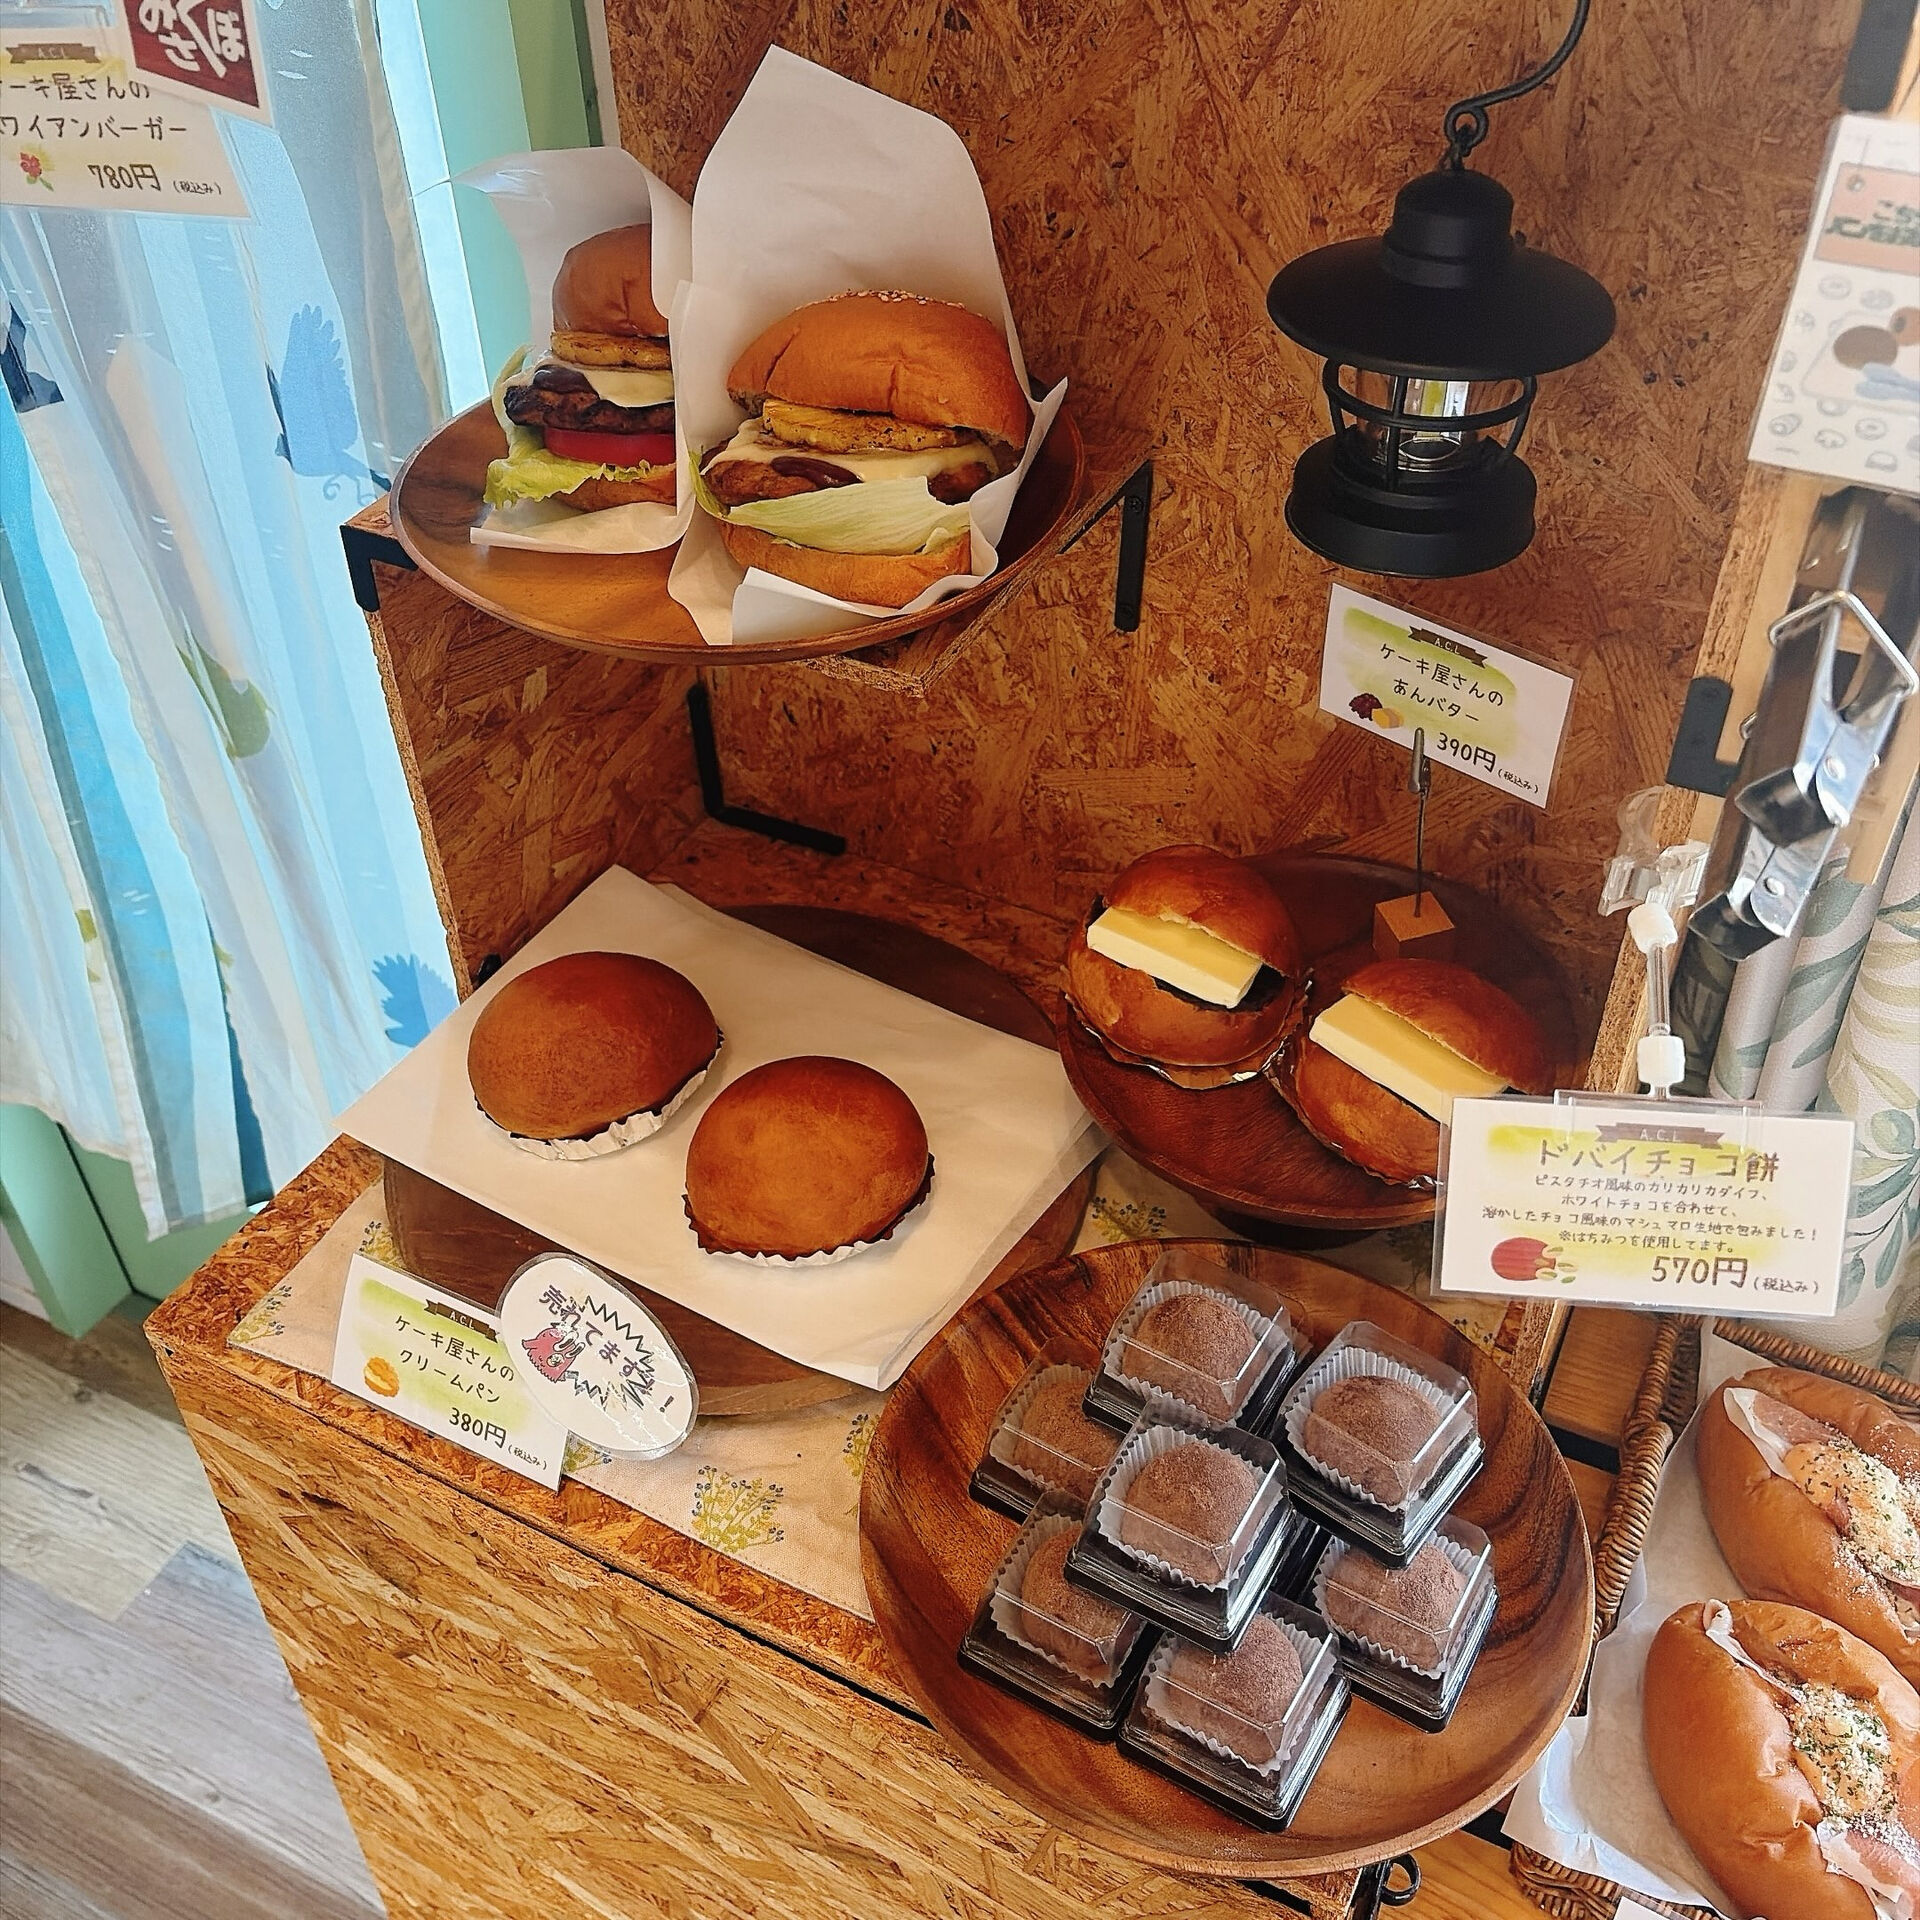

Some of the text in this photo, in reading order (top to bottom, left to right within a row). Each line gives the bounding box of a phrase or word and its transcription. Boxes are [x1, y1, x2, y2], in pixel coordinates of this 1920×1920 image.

[0, 73, 150, 100] ーキ屋さんの
[0, 114, 187, 141] ワイアンバーガー
[87, 163, 161, 192] 780円
[1380, 643, 1503, 707] ケーキ屋さんの
[1393, 678, 1480, 722] あんバター
[1436, 732, 1496, 773] 390円
[1540, 1139, 1780, 1183] ドバイチョコ餅
[1561, 1193, 1737, 1217] ホワイトチョコを合わせて、
[1652, 1255, 1748, 1288] 570円
[395, 1315, 514, 1382] ケーキ屋さんの
[400, 1348, 501, 1404] クリームパン
[448, 1407, 507, 1450] 380円
